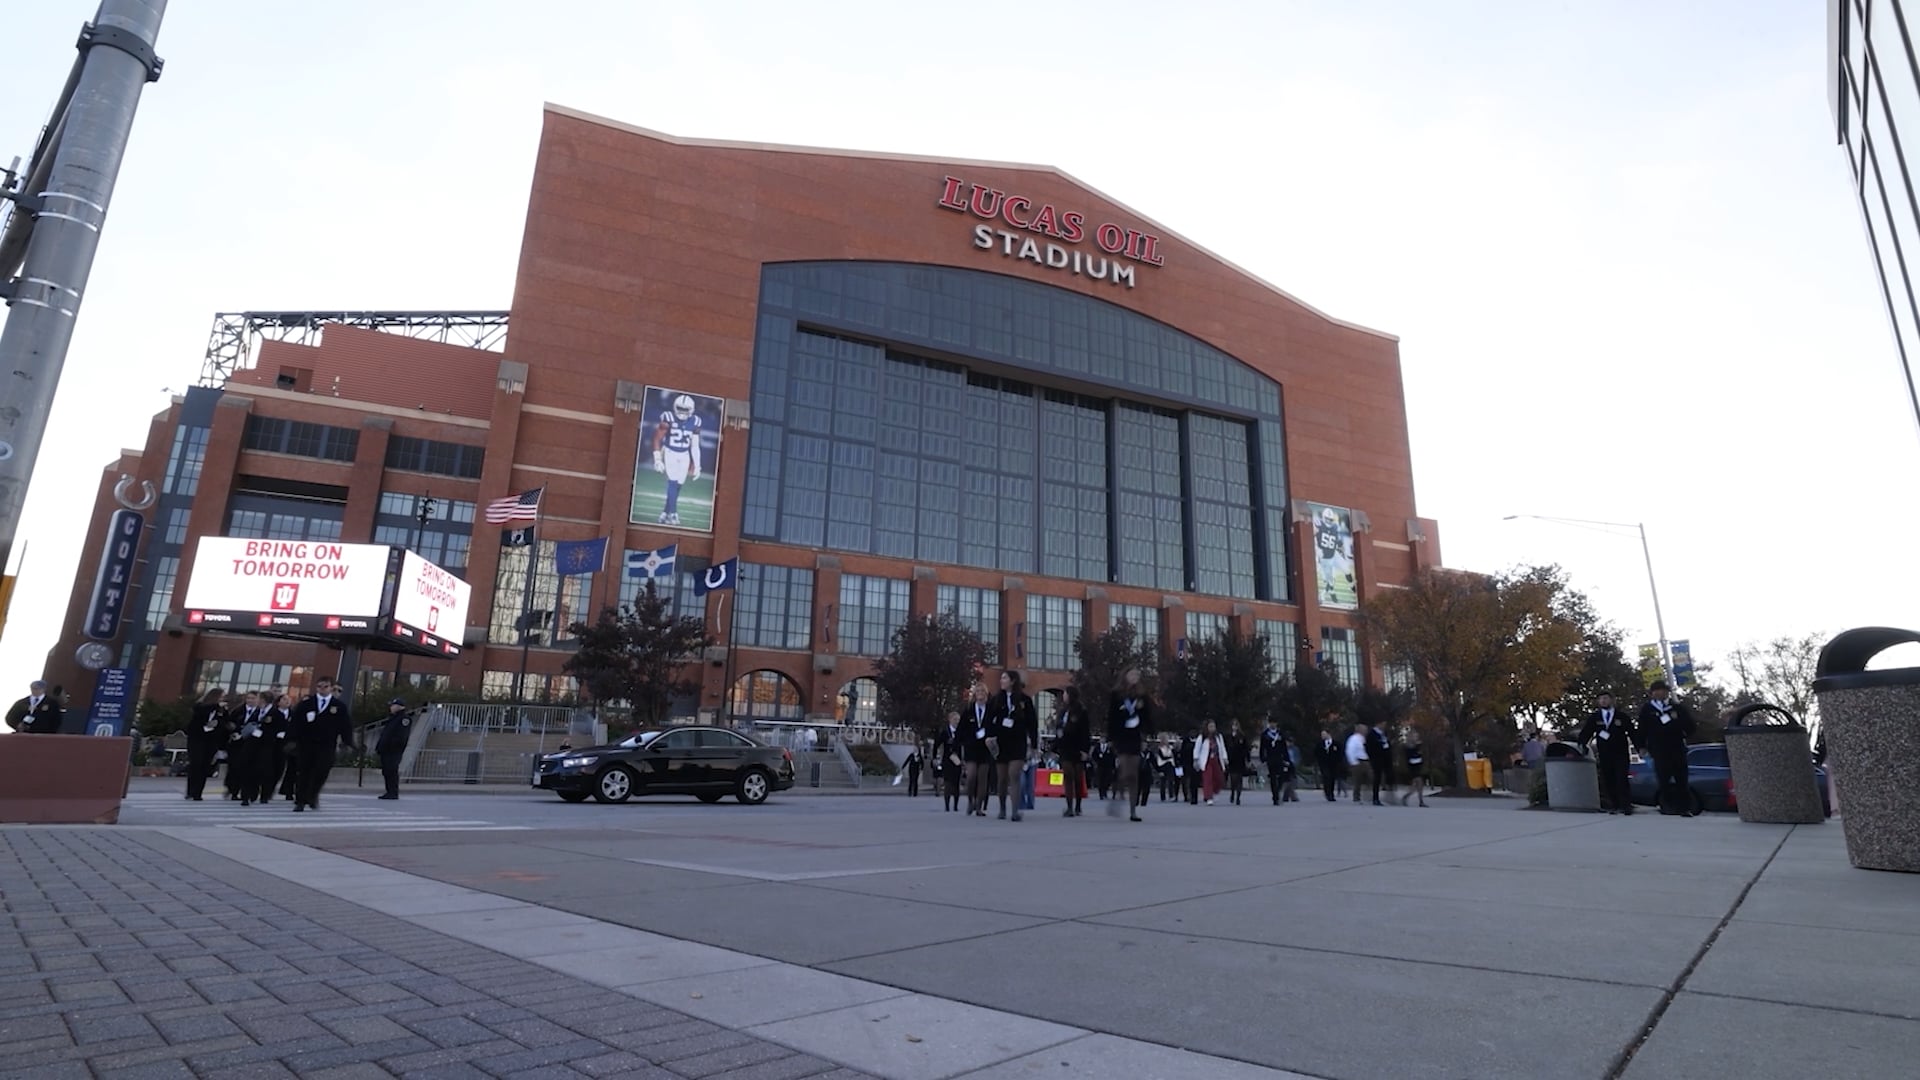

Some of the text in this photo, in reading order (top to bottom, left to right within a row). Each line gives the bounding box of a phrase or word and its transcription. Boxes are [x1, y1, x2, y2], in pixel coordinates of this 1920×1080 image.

[939, 176, 1164, 266] LUCAS OIL
[974, 224, 1135, 288] STADIUM
[669, 429, 692, 448] 23
[1321, 532, 1335, 549] 56
[246, 541, 342, 560] BRING ON
[99, 517, 136, 632] COLTS
[233, 560, 349, 580] TOMORROW
[422, 562, 456, 592] BRING ON
[416, 578, 456, 610] TOMORROW
[204, 614, 231, 622] TOYOTA
[273, 617, 299, 625] TOYOTA
[341, 620, 367, 628] TOYOTA
